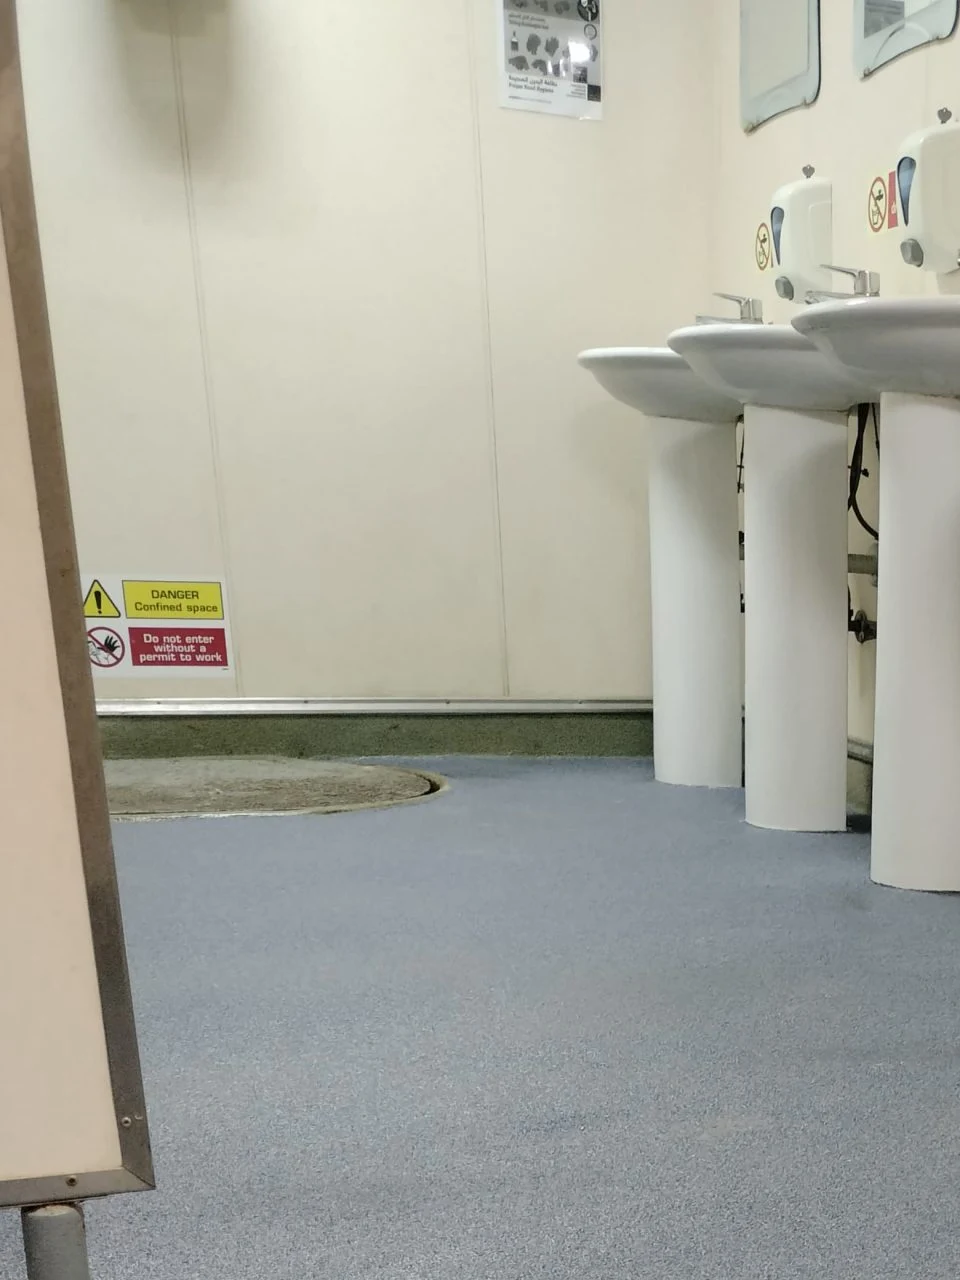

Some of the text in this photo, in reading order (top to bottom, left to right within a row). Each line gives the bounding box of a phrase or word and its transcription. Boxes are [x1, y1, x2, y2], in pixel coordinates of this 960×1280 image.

[151, 589, 200, 600] DANGER
[134, 601, 218, 614] Confined space
[143, 633, 215, 644] Do not enter
[153, 643, 196, 653] without
[139, 652, 222, 663] permit to work
